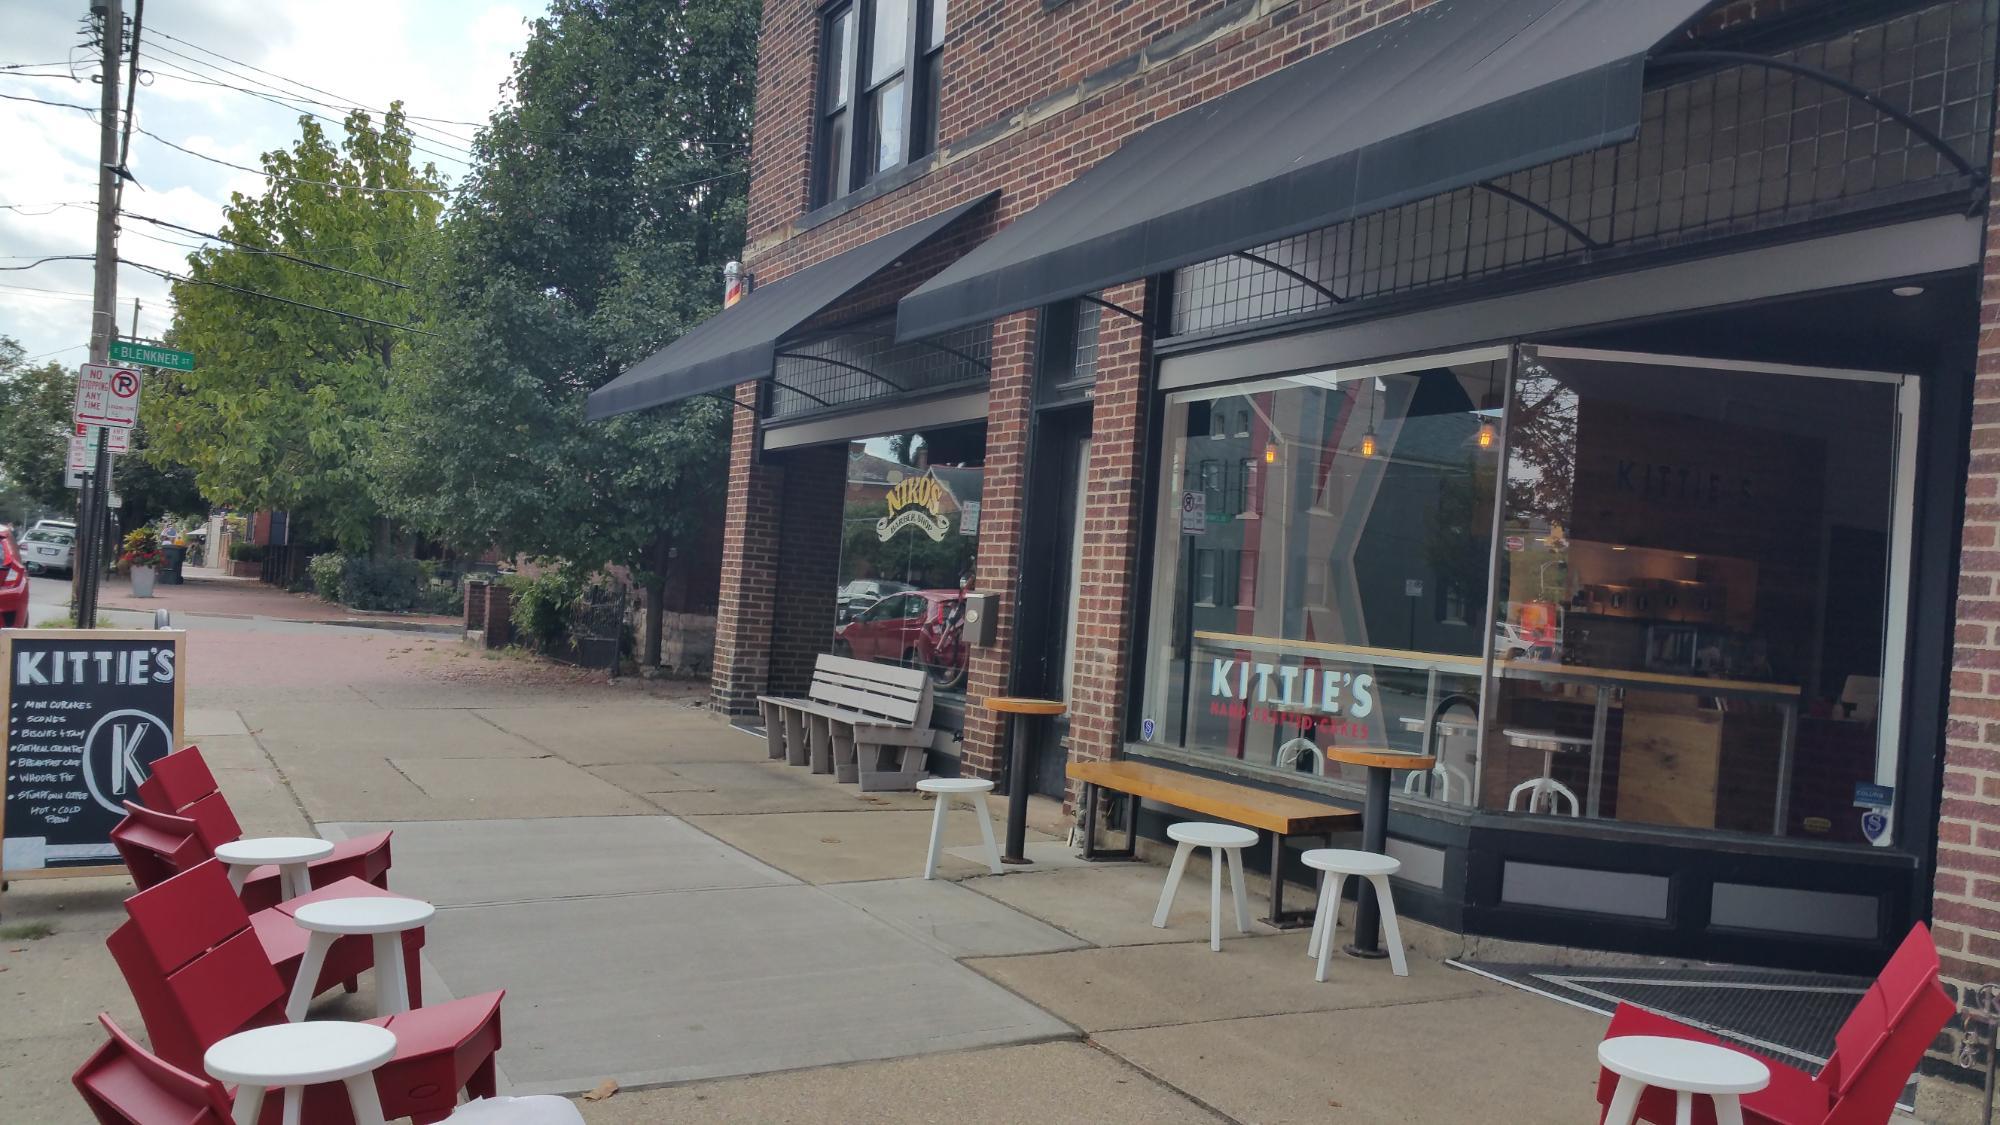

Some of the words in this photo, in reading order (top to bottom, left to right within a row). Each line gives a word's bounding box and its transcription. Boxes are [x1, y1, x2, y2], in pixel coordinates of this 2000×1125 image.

[121, 347, 179, 365] BLENKNER
[90, 369, 103, 380] NO
[85, 391, 101, 401] ANY
[83, 401, 101, 411] TIME
[1617, 459, 1753, 504] KITTIES
[890, 513, 916, 533] BARBER
[917, 514, 933, 531] SHOP
[16, 647, 175, 686] KITTIE'S
[1211, 658, 1374, 718] KITTIE'S
[24, 701, 47, 709] MINI
[49, 701, 93, 710] CUPCAKES
[1210, 701, 1247, 720] HAND
[21, 729, 57, 738] BISCUITS
[20, 773, 57, 783] WHOOPIE
[30, 806, 50, 815] HOT
[57, 806, 81, 814] COLD
[44, 815, 70, 824] BREW
